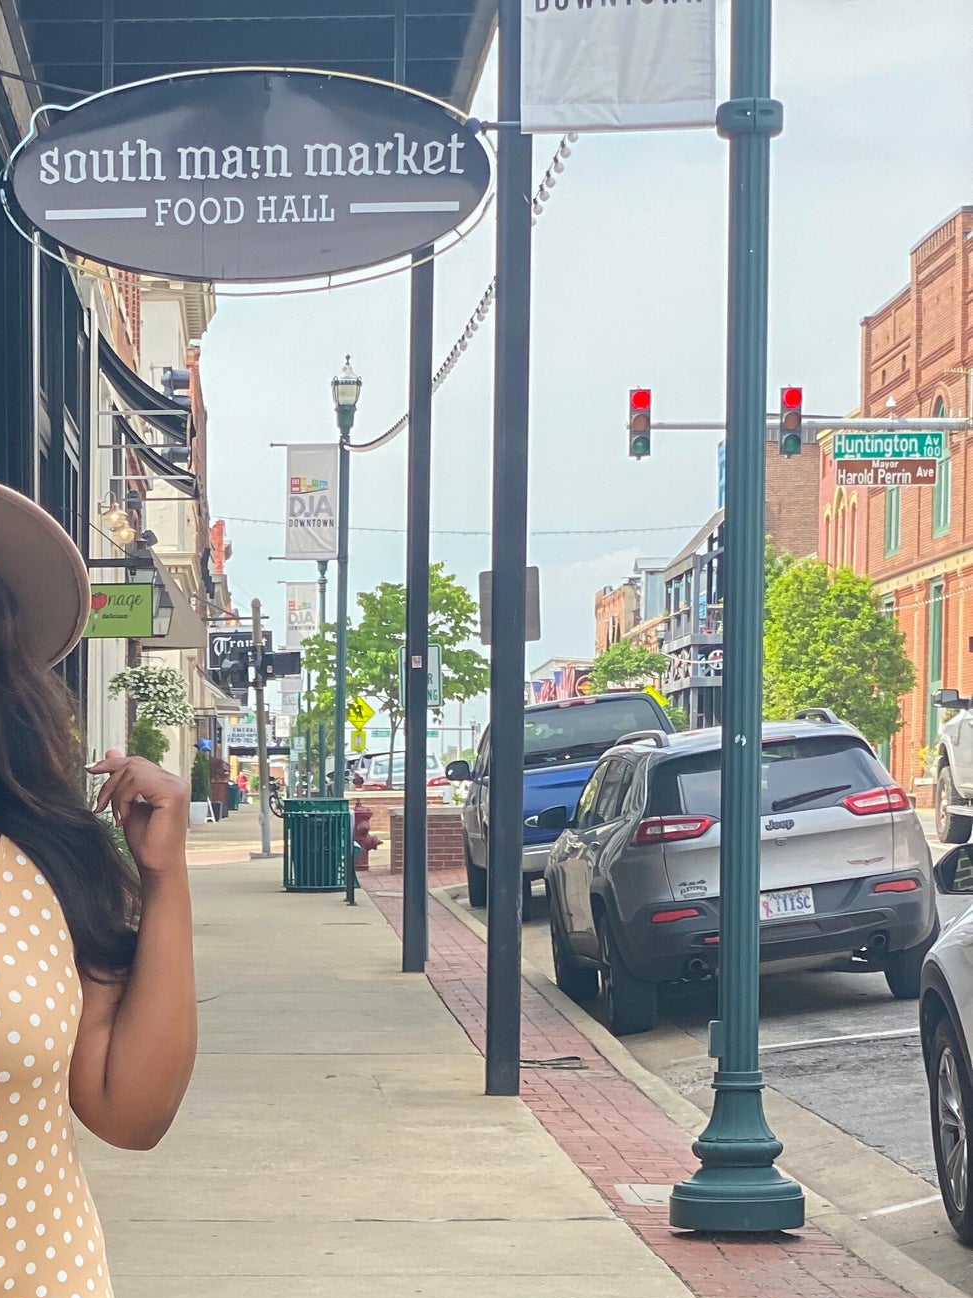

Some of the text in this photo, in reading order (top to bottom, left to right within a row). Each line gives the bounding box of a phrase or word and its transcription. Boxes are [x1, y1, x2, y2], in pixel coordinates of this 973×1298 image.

[39, 133, 465, 185] south main market
[154, 195, 335, 226] FOOD HALL
[834, 434, 939, 458] Huntington Av
[923, 446, 941, 457] 100
[871, 459, 899, 470] Mayor
[838, 466, 934, 484] Harold Perrin Ave
[289, 495, 334, 518] DJA
[288, 518, 335, 528] DOWNTOWN
[288, 611, 315, 625] DJA
[765, 819, 795, 830] Jeep
